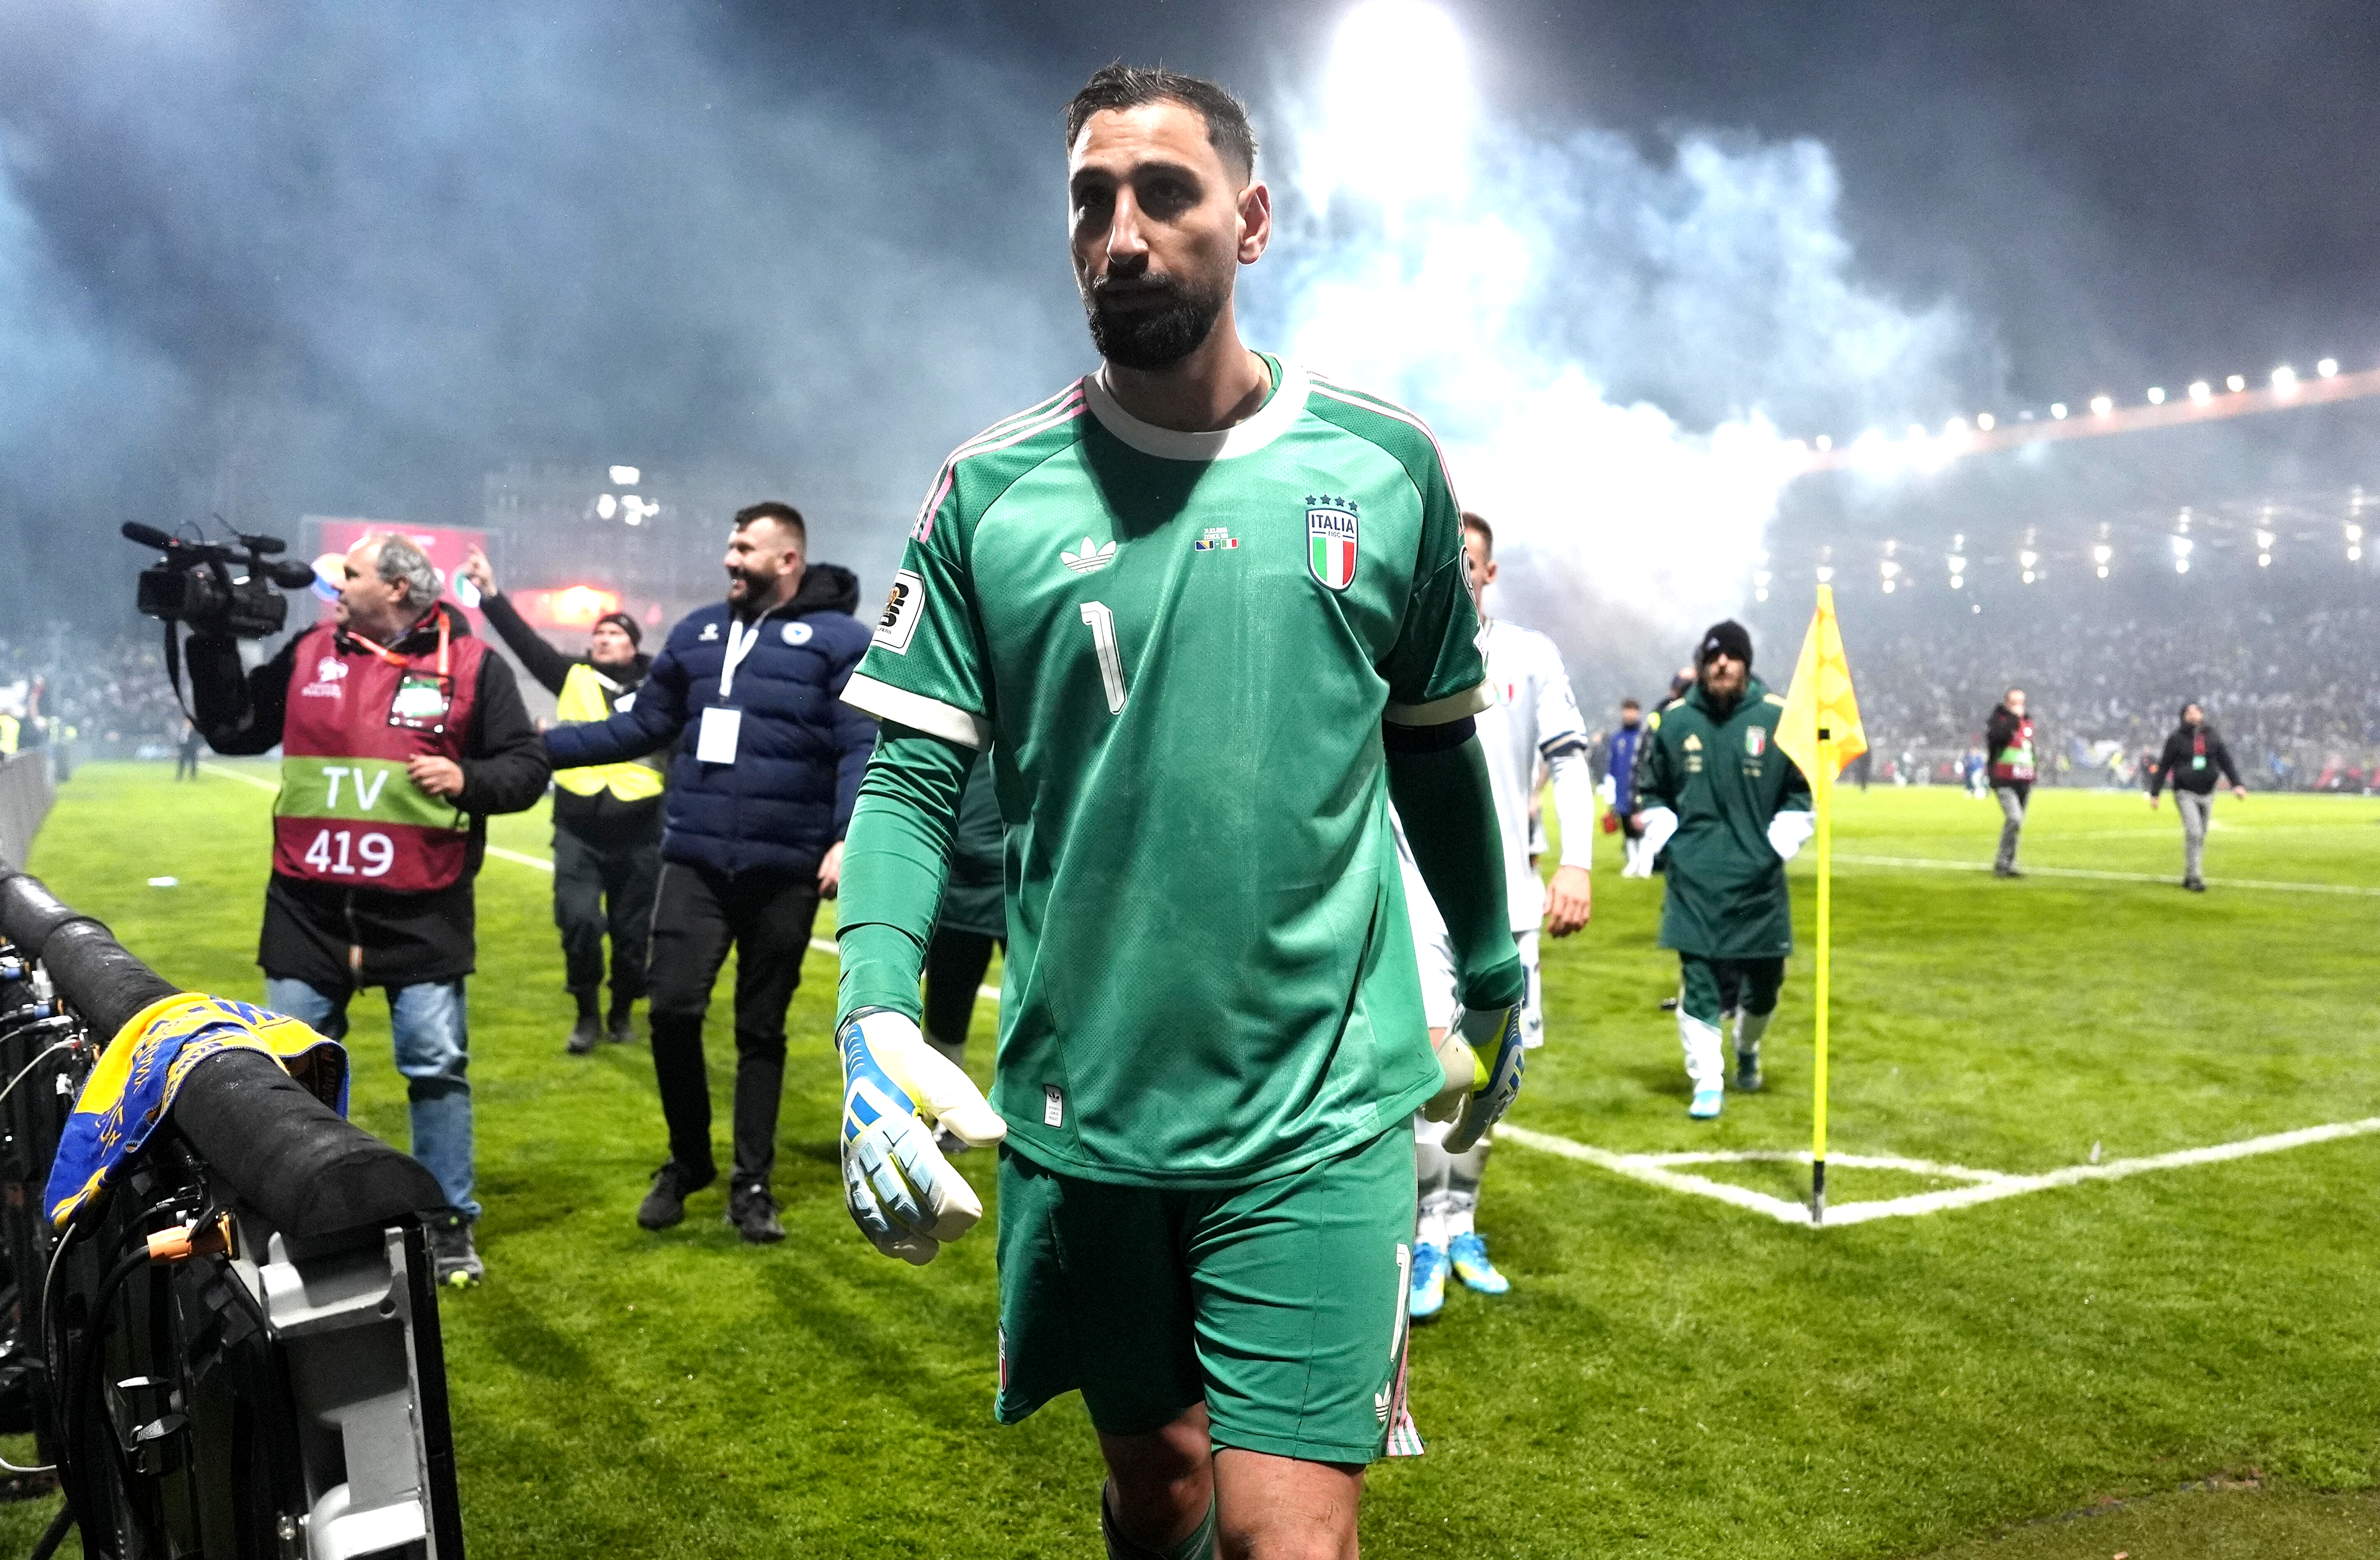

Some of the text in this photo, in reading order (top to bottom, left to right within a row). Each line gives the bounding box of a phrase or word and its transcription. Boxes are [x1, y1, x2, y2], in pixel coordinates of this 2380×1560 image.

[1311, 514, 1354, 534] ITALIA
[1079, 601, 1128, 715] 1
[322, 766, 389, 811] TV
[305, 829, 394, 877] 419
[1390, 1243, 1410, 1363] 1
